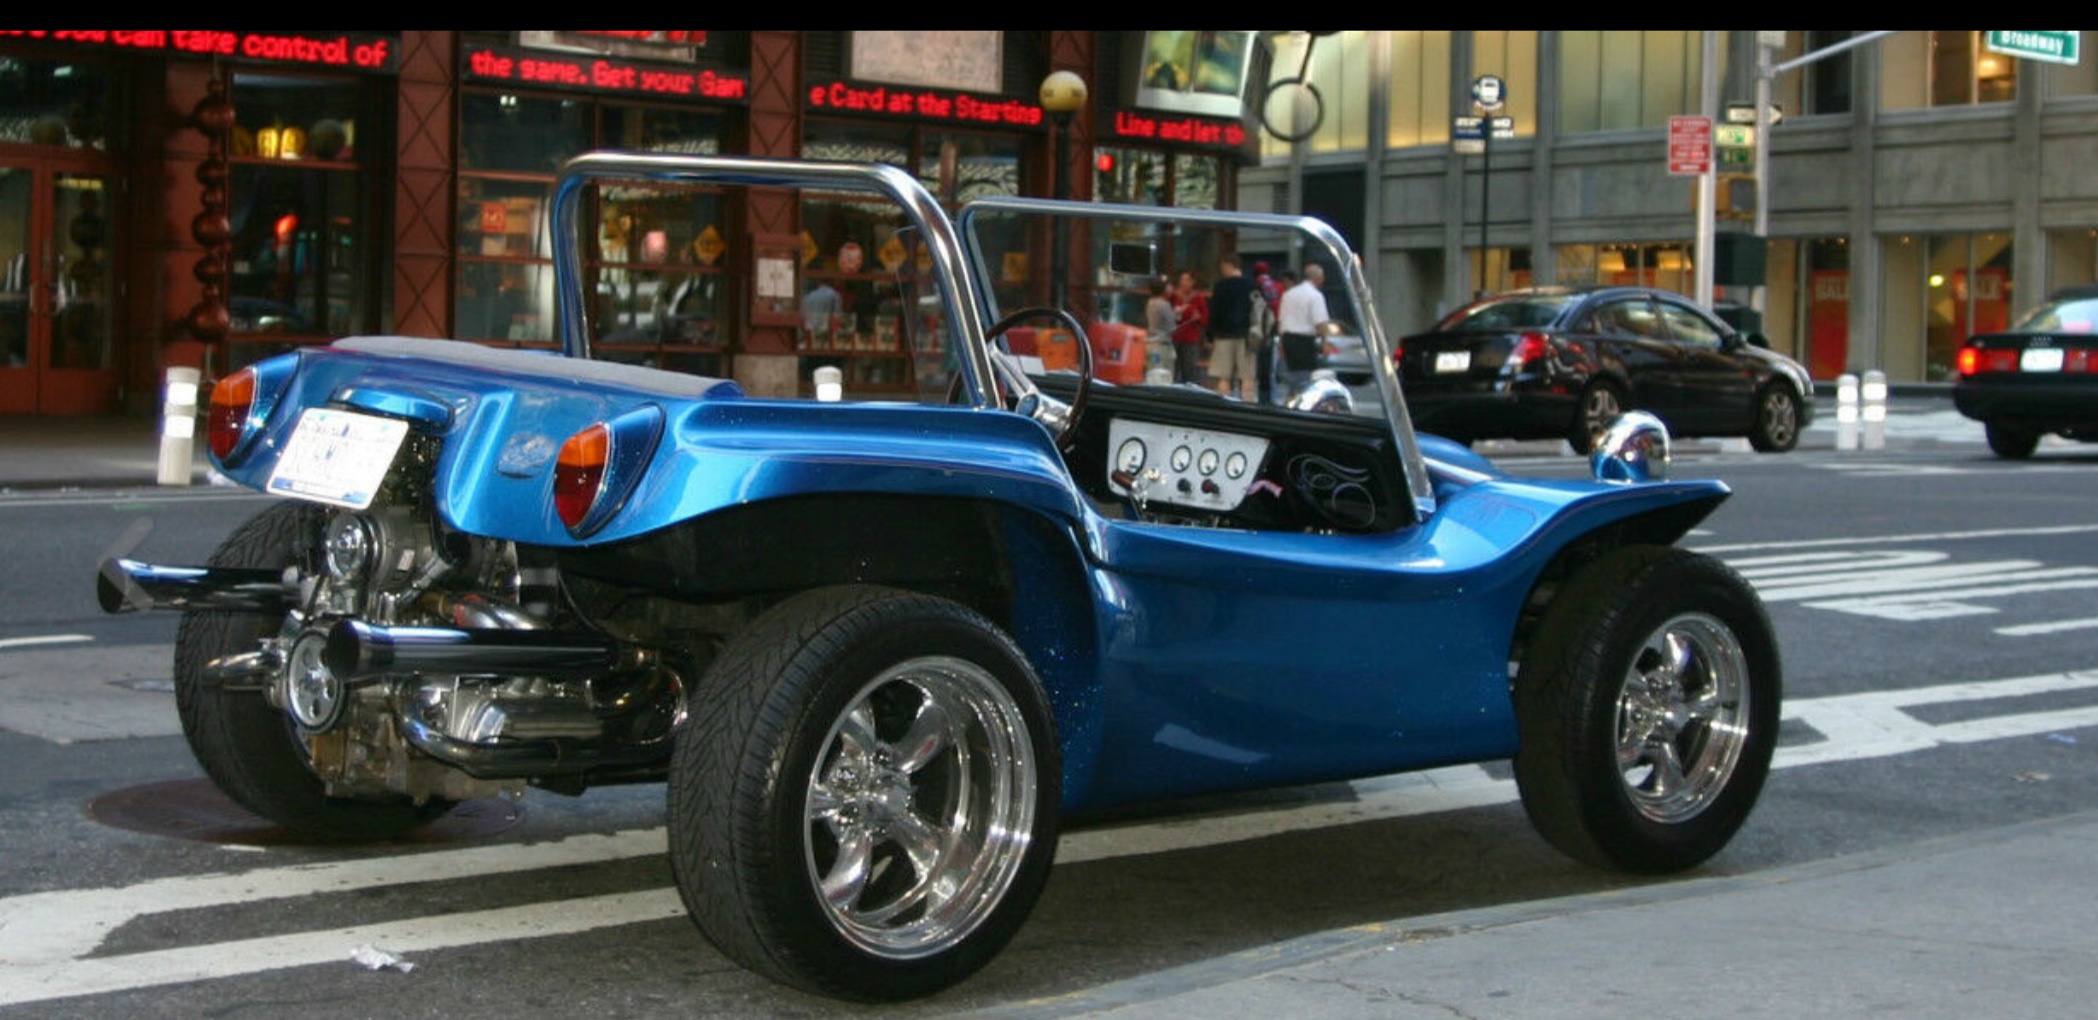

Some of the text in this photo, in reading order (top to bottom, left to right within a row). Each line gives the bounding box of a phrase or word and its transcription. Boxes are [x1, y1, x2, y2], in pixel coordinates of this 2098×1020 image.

[111, 29, 166, 48] can
[171, 29, 238, 55] take
[242, 34, 349, 64] control
[353, 40, 388, 67] of
[469, 49, 514, 78] the
[591, 60, 637, 88] Get
[639, 71, 694, 93] your
[697, 69, 746, 98] Gam
[828, 82, 886, 111] Card
[888, 92, 914, 113] at
[915, 91, 950, 117] the
[954, 94, 1044, 126] Starting
[1115, 111, 1156, 138] Line
[1158, 118, 1192, 142] and
